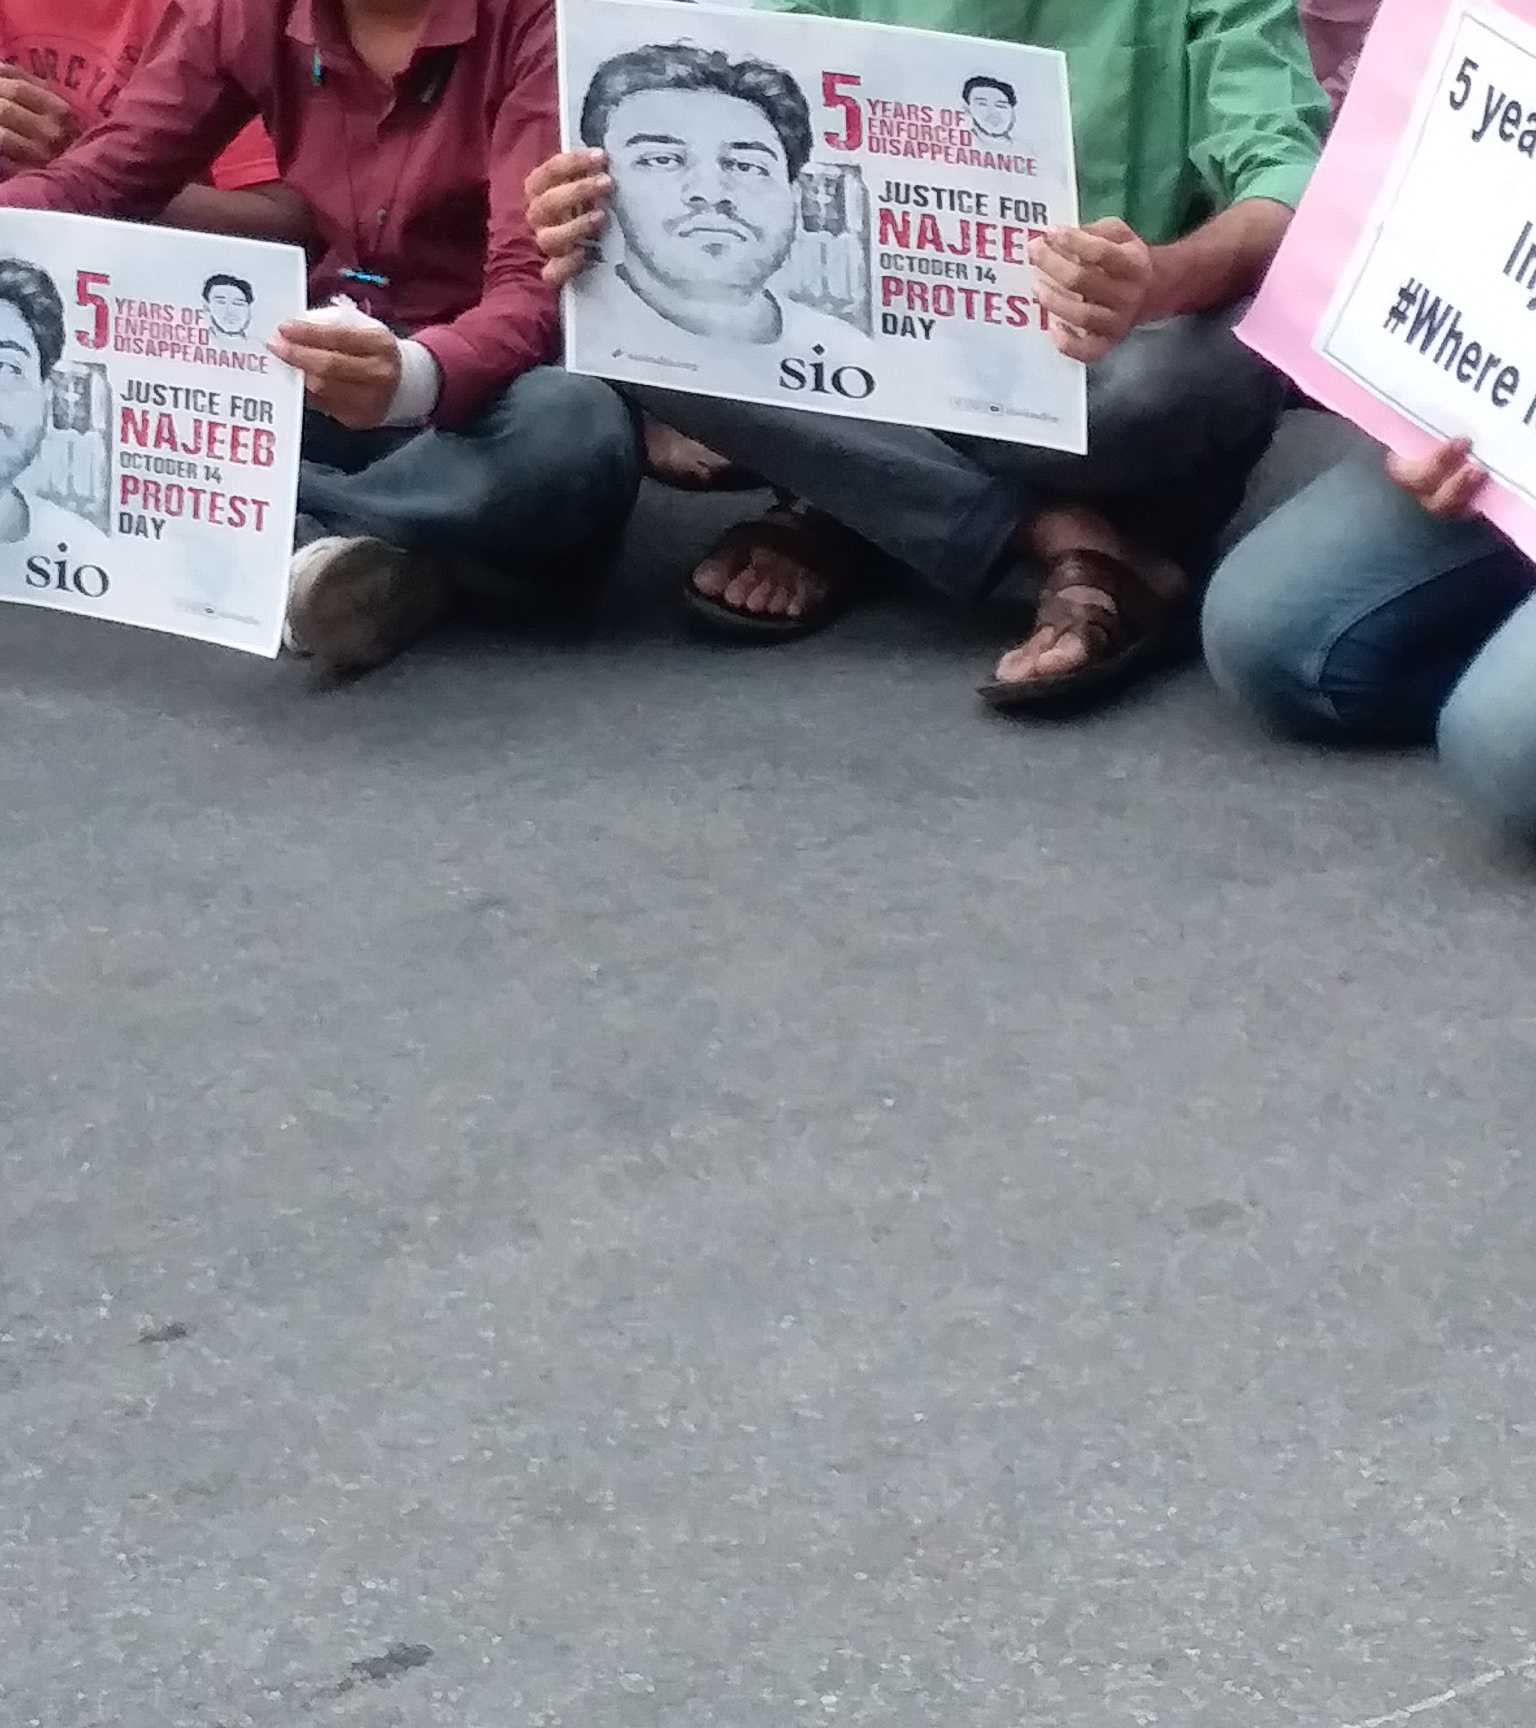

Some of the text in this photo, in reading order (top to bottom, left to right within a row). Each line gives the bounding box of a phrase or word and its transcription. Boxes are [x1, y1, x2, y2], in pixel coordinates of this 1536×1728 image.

[1448, 57, 1479, 111] 5
[821, 70, 863, 152] 5
[866, 97, 967, 129] YEARS OF
[867, 117, 974, 147] ENFORCED
[867, 136, 1039, 177] DISAPPEARANCE
[877, 179, 1049, 226] JUSTICE FOR
[877, 207, 1047, 266] NAJEE
[879, 251, 997, 284] OCTOBER 14
[75, 269, 110, 351] 5
[113, 295, 206, 326] YEARS OF
[880, 275, 1051, 331] PROTEST
[881, 311, 937, 341] DAY
[114, 315, 210, 345] ENFORCED
[1382, 277, 1520, 407] #Where
[113, 334, 269, 374] DISAPPEARANCE
[778, 343, 876, 400] sio
[120, 377, 275, 425] JUSTICE FOR
[120, 406, 276, 468] NAJEEB
[119, 450, 223, 485] OCTOBER 14
[119, 473, 270, 532] PROTEST
[119, 512, 166, 541] DAY
[25, 542, 110, 599] sio
